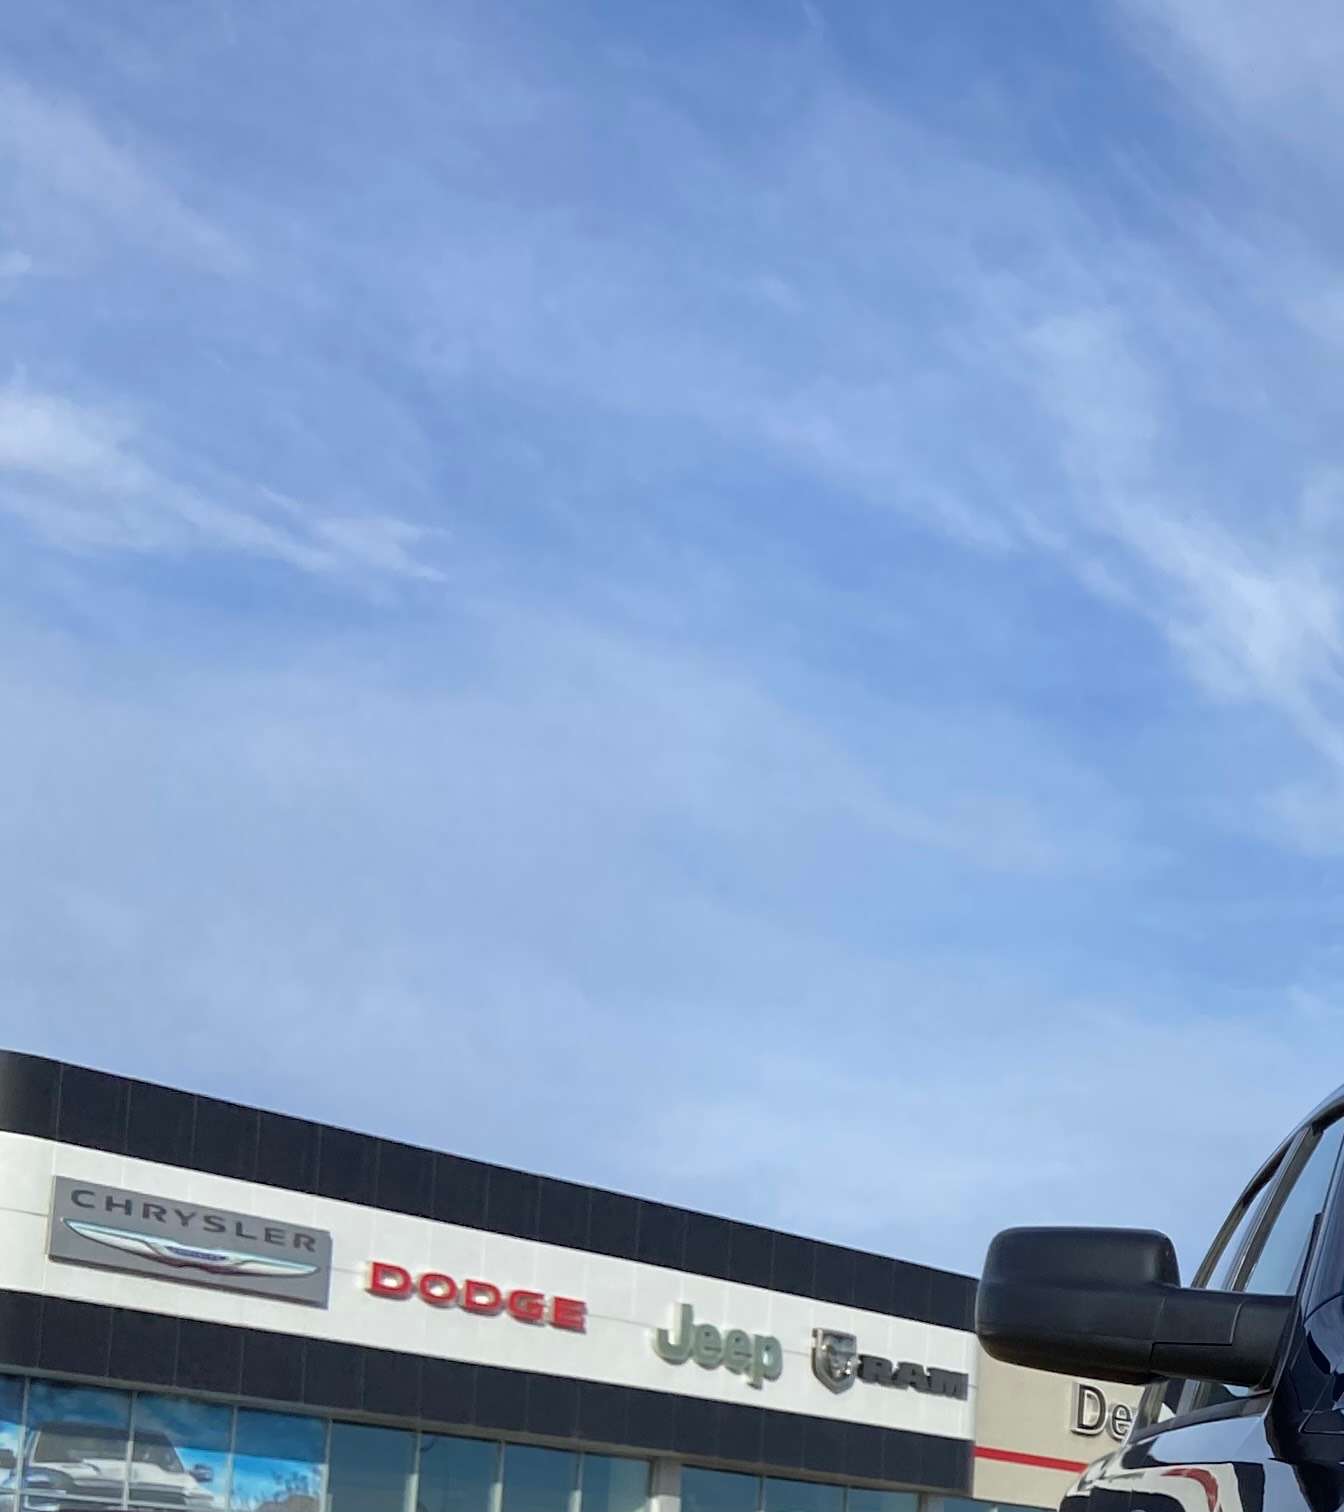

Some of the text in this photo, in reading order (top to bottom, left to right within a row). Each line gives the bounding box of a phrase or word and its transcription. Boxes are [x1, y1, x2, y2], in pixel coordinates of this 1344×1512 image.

[70, 1188, 317, 1253] CHRYSLER
[367, 1261, 587, 1333] DODGE
[654, 1302, 783, 1388] Jeep
[858, 1355, 969, 1401] RAM
